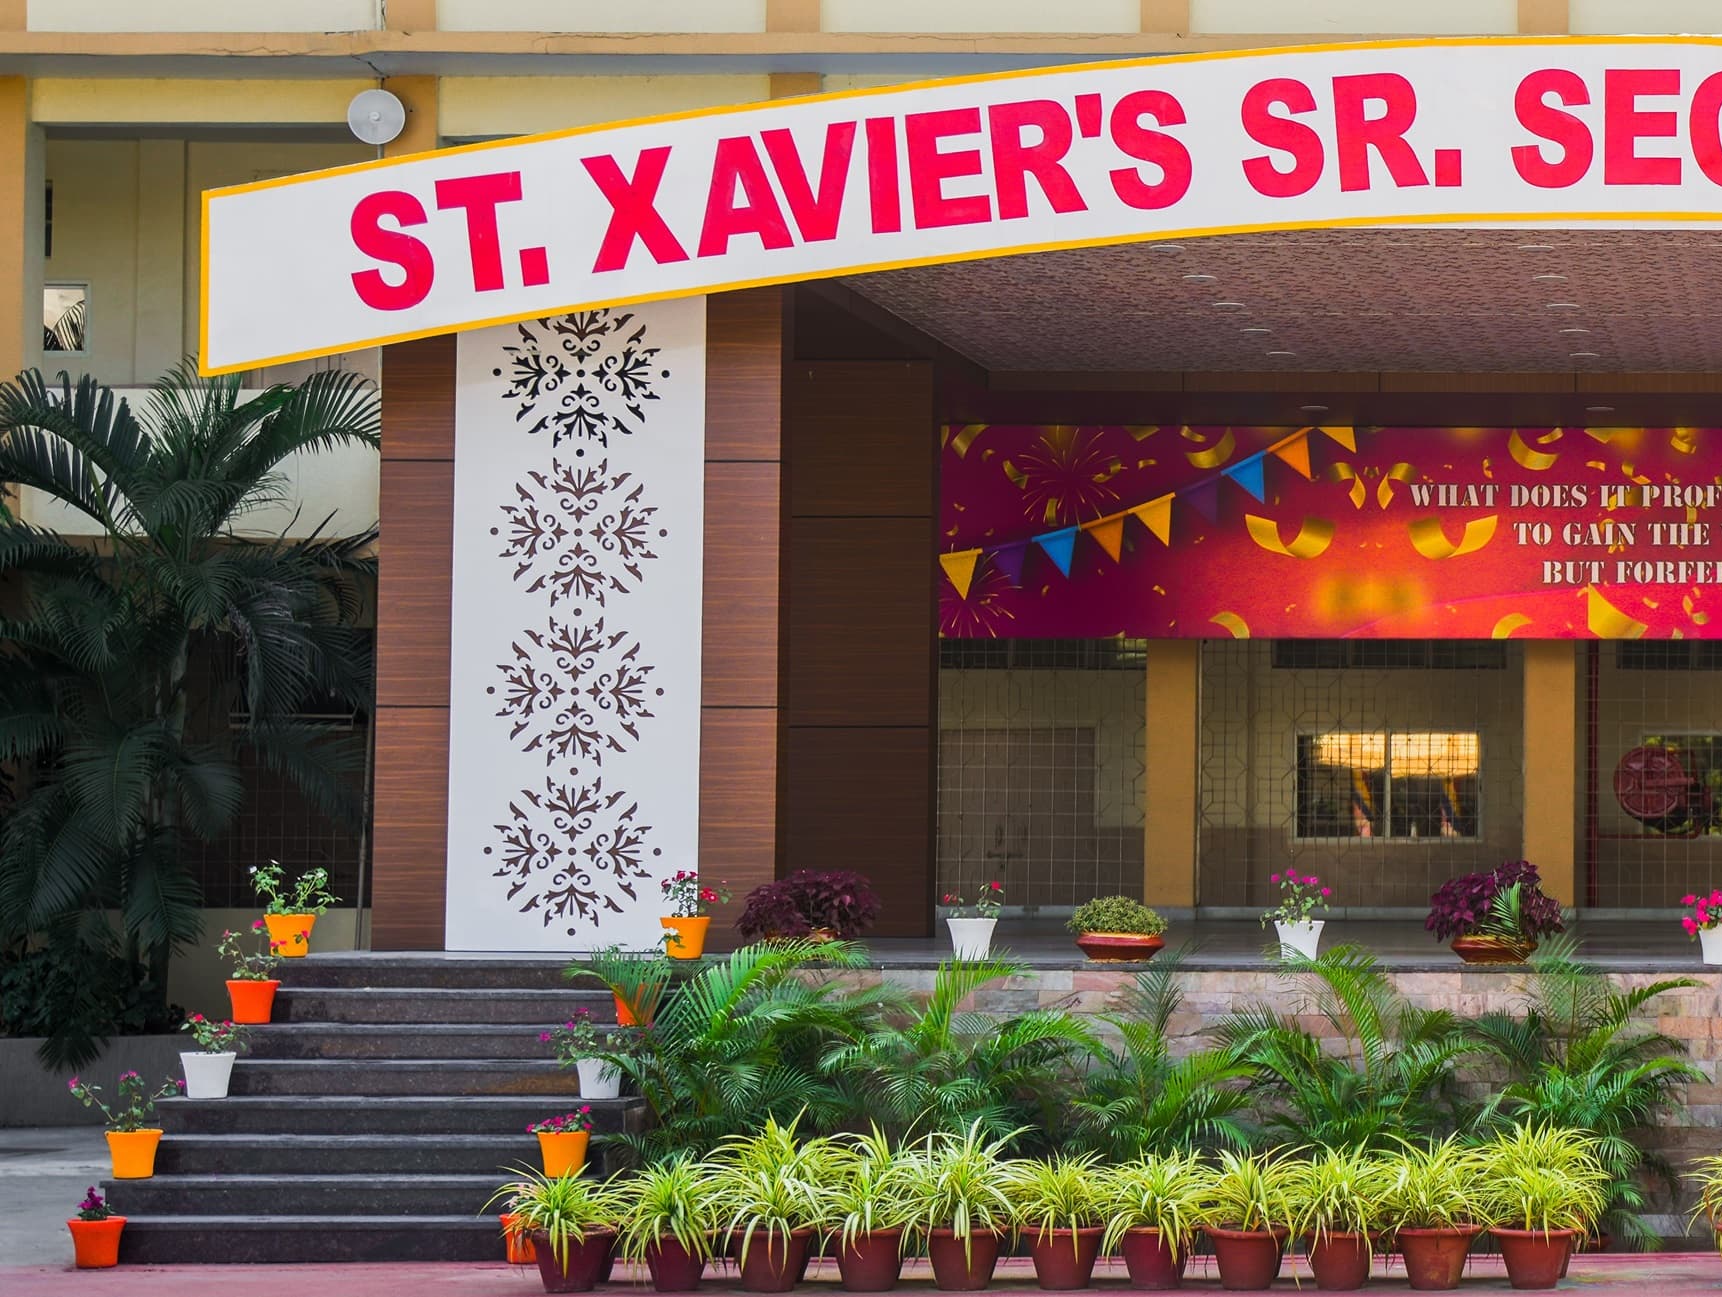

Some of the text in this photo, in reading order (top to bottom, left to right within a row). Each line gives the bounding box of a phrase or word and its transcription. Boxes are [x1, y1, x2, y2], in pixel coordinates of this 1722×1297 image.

[351, 171, 550, 312] ST.
[581, 89, 1193, 273] XAVIER'S
[1241, 72, 1463, 199] SR.
[1409, 484, 1499, 507] WHAT
[1509, 484, 1588, 508] DOES
[1600, 484, 1631, 508] IT
[1513, 522, 1553, 545] TO
[1562, 522, 1637, 546] GAIN
[1647, 522, 1711, 546] THE
[1541, 560, 1605, 584] BUT
